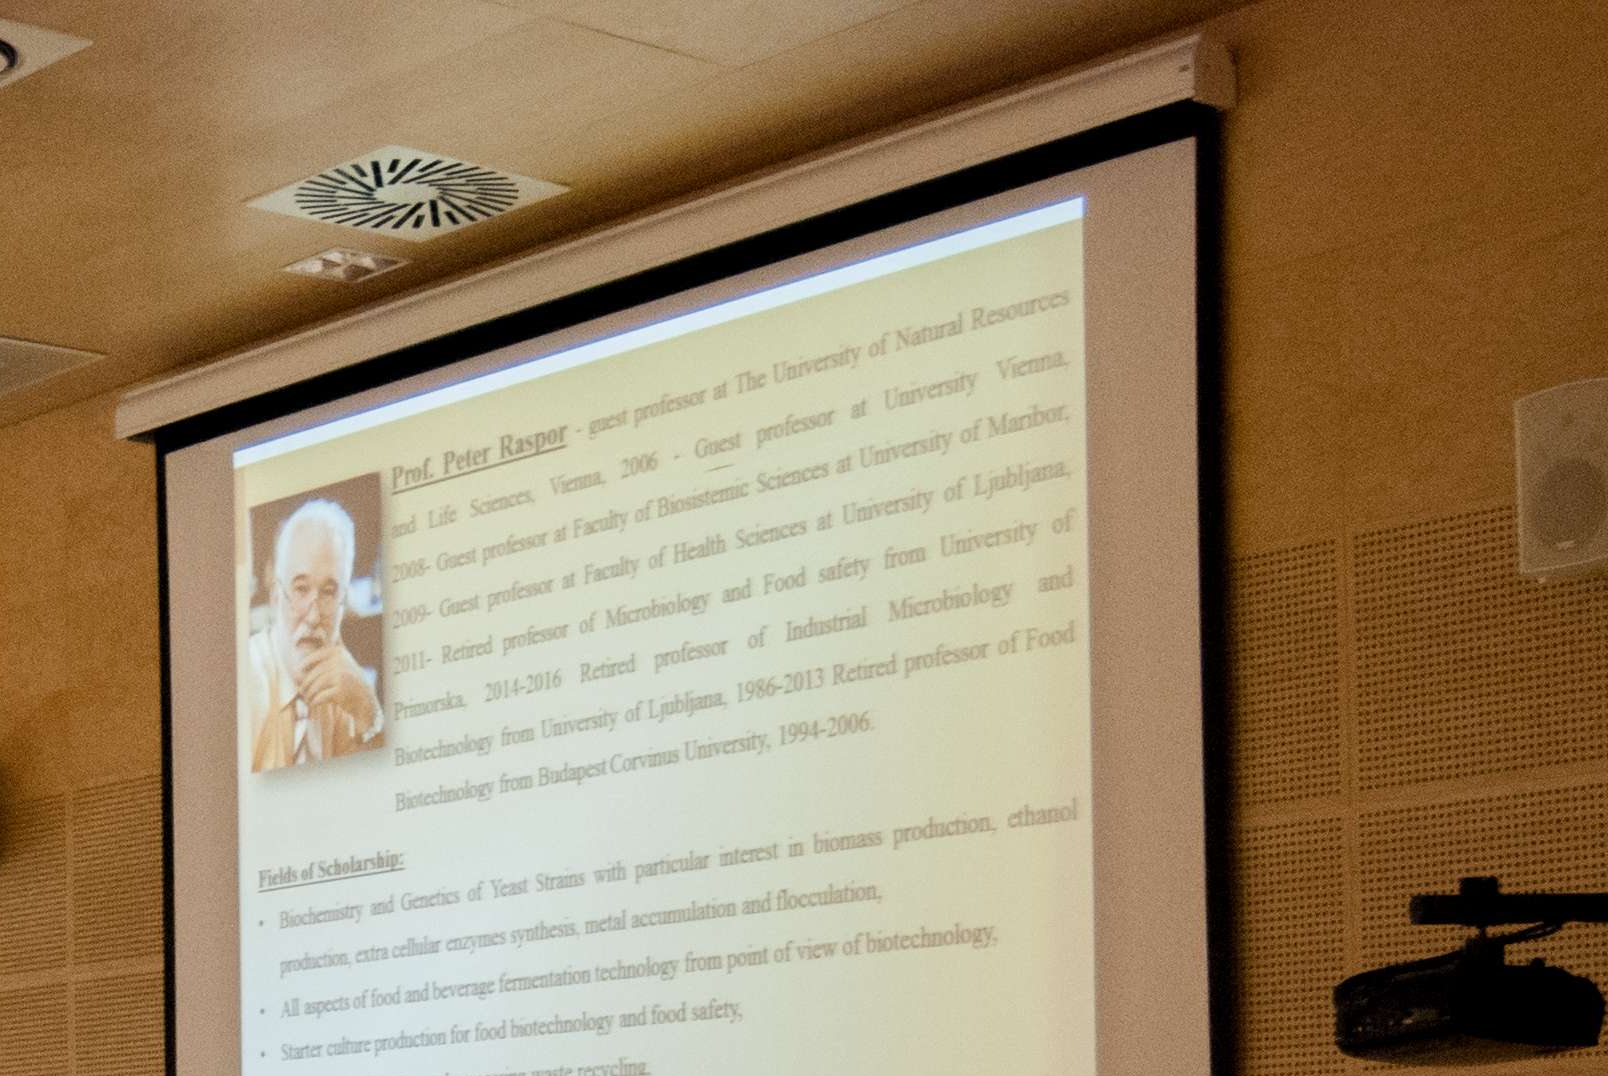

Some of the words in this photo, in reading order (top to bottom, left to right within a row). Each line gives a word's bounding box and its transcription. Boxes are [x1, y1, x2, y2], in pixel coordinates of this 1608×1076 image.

[442, 446, 491, 473] Peter
[499, 424, 568, 458] Raspor
[588, 408, 628, 440] guest
[633, 388, 707, 428] professor
[713, 380, 727, 400] at
[734, 370, 766, 394] The
[772, 345, 861, 383] University
[894, 311, 964, 351] Natural
[971, 290, 1069, 330] Resources
[391, 513, 417, 538] and
[427, 504, 457, 529] Life
[693, 431, 742, 459] Guest
[755, 409, 836, 449] professor
[850, 398, 867, 419] at
[884, 371, 978, 410] University
[435, 547, 477, 571] Guest
[482, 531, 548, 566] professor
[553, 524, 567, 543] at
[572, 508, 628, 538] Faculty
[755, 462, 830, 493] Sciences
[835, 453, 853, 474] at
[858, 430, 953, 468] University
[438, 593, 480, 617] Guest
[486, 578, 554, 612] professor
[561, 570, 576, 589] at
[583, 555, 639, 585] Faculty
[673, 532, 726, 564] Health
[735, 519, 808, 549] Sciences
[816, 510, 833, 531] at
[842, 488, 934, 525] University
[441, 634, 493, 664] Retired
[502, 623, 569, 656] professor
[605, 592, 710, 628] Microbiology
[721, 577, 752, 603] and
[763, 565, 807, 595] Food
[818, 556, 870, 583] safety
[883, 545, 927, 570] from
[940, 522, 1037, 557] University
[579, 652, 636, 683] Retired
[653, 639, 728, 674] professor
[785, 605, 867, 642] Industrial
[888, 582, 1014, 622] Microbiology
[1037, 564, 1074, 592] and
[394, 733, 494, 766] Biotechnology
[500, 725, 535, 746] from
[540, 708, 618, 738] University
[832, 652, 897, 685] Retired
[903, 642, 990, 678] professor
[997, 629, 1021, 655] of
[1025, 619, 1076, 651] Food
[395, 779, 494, 812] Biotechnology
[498, 772, 533, 793] from
[537, 758, 607, 786] Budapest
[608, 747, 680, 773] Corvinus
[258, 866, 297, 887] Fields
[300, 862, 314, 880] of
[318, 850, 403, 877] Scholarship:
[279, 903, 363, 929] Biochemistry
[370, 894, 394, 916] and
[400, 887, 460, 911] Genetics
[466, 880, 484, 901] of
[489, 877, 528, 898] Yeast
[535, 869, 585, 892] Strains
[593, 860, 626, 882] with
[634, 850, 710, 884] particular
[718, 842, 779, 867] interest
[788, 836, 804, 857] in
[812, 830, 883, 854] biomass
[1007, 796, 1078, 828] ethanol
[354, 945, 389, 963] extra
[391, 935, 441, 958] cellular
[445, 931, 506, 954] enzymes
[584, 909, 626, 934] metal
[630, 898, 737, 928] accumulation
[741, 890, 772, 915] and
[280, 997, 299, 1018] All
[303, 996, 350, 1018] aspects
[352, 988, 368, 1009] of
[370, 985, 401, 1007] food
[404, 981, 429, 1003] and
[431, 980, 495, 1000] beverage
[498, 965, 591, 993] fermentation
[594, 955, 679, 982] technology
[684, 950, 723, 972] from
[726, 945, 769, 974] point
[773, 939, 794, 963] of
[795, 938, 837, 960] view
[841, 932, 863, 955] of
[280, 1043, 323, 1060] Starter
[326, 1036, 372, 1056] culture
[373, 1027, 446, 1057] production
[449, 1023, 470, 1044] for
[474, 1019, 507, 1041] food
[510, 1011, 614, 1038] biotechnology
[618, 1005, 647, 1027] and
[650, 1001, 687, 1025] food
